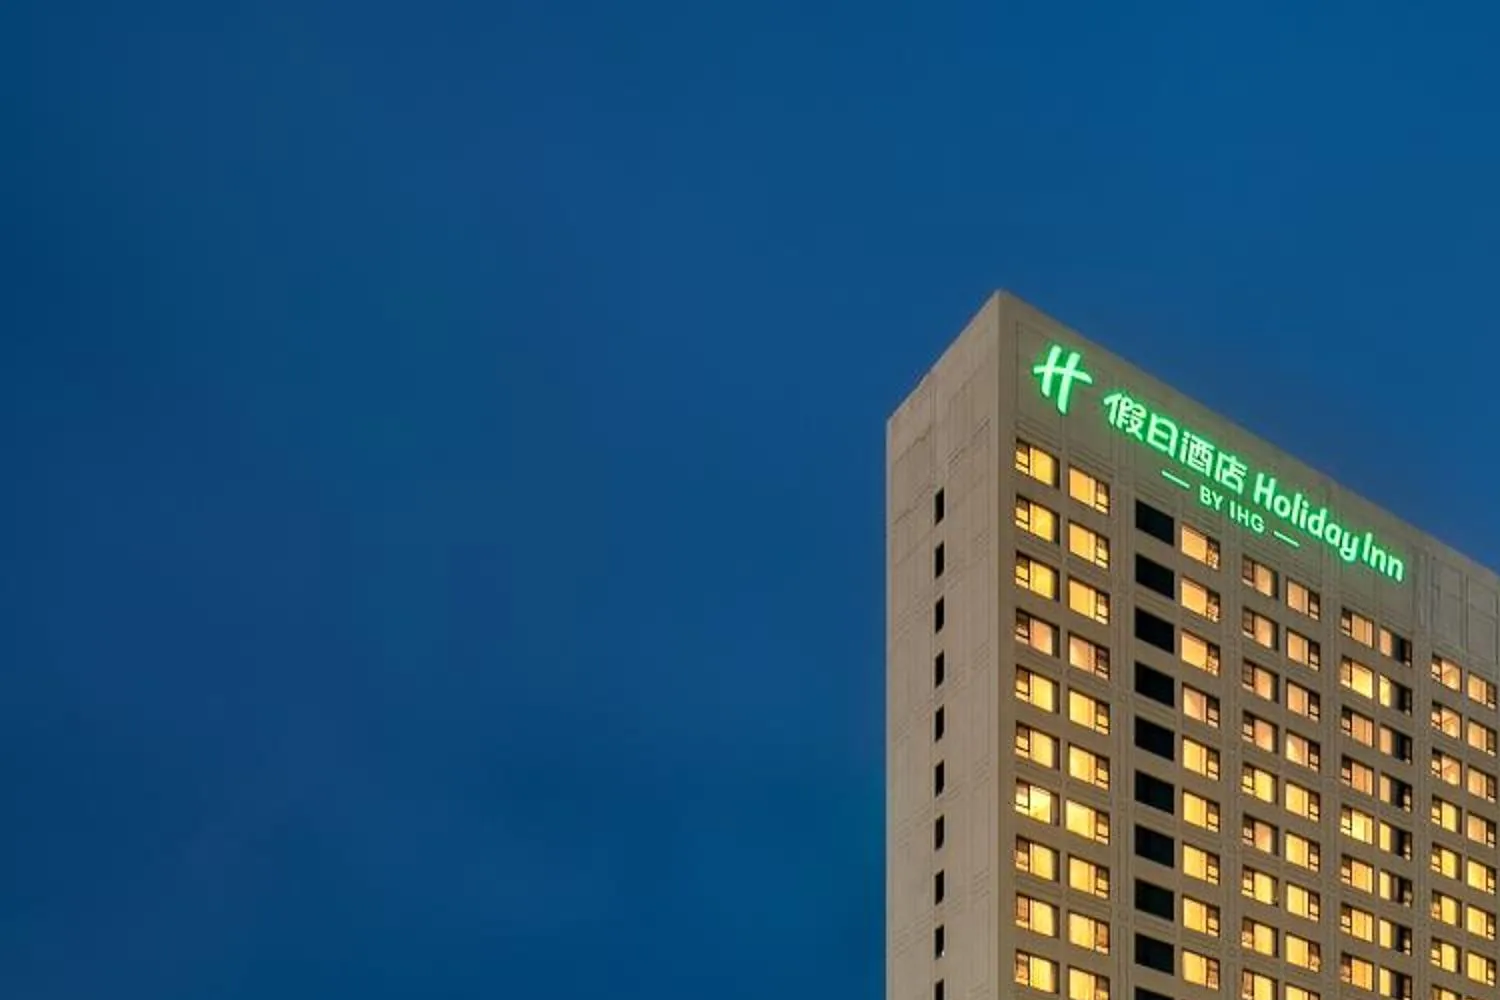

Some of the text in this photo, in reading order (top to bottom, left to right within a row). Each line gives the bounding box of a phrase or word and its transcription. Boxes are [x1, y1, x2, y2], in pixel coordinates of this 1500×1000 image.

[1103, 390, 1248, 495] 假日酒店
[1199, 484, 1265, 534] BY IHG
[1253, 472, 1405, 581] Holiday Inn
